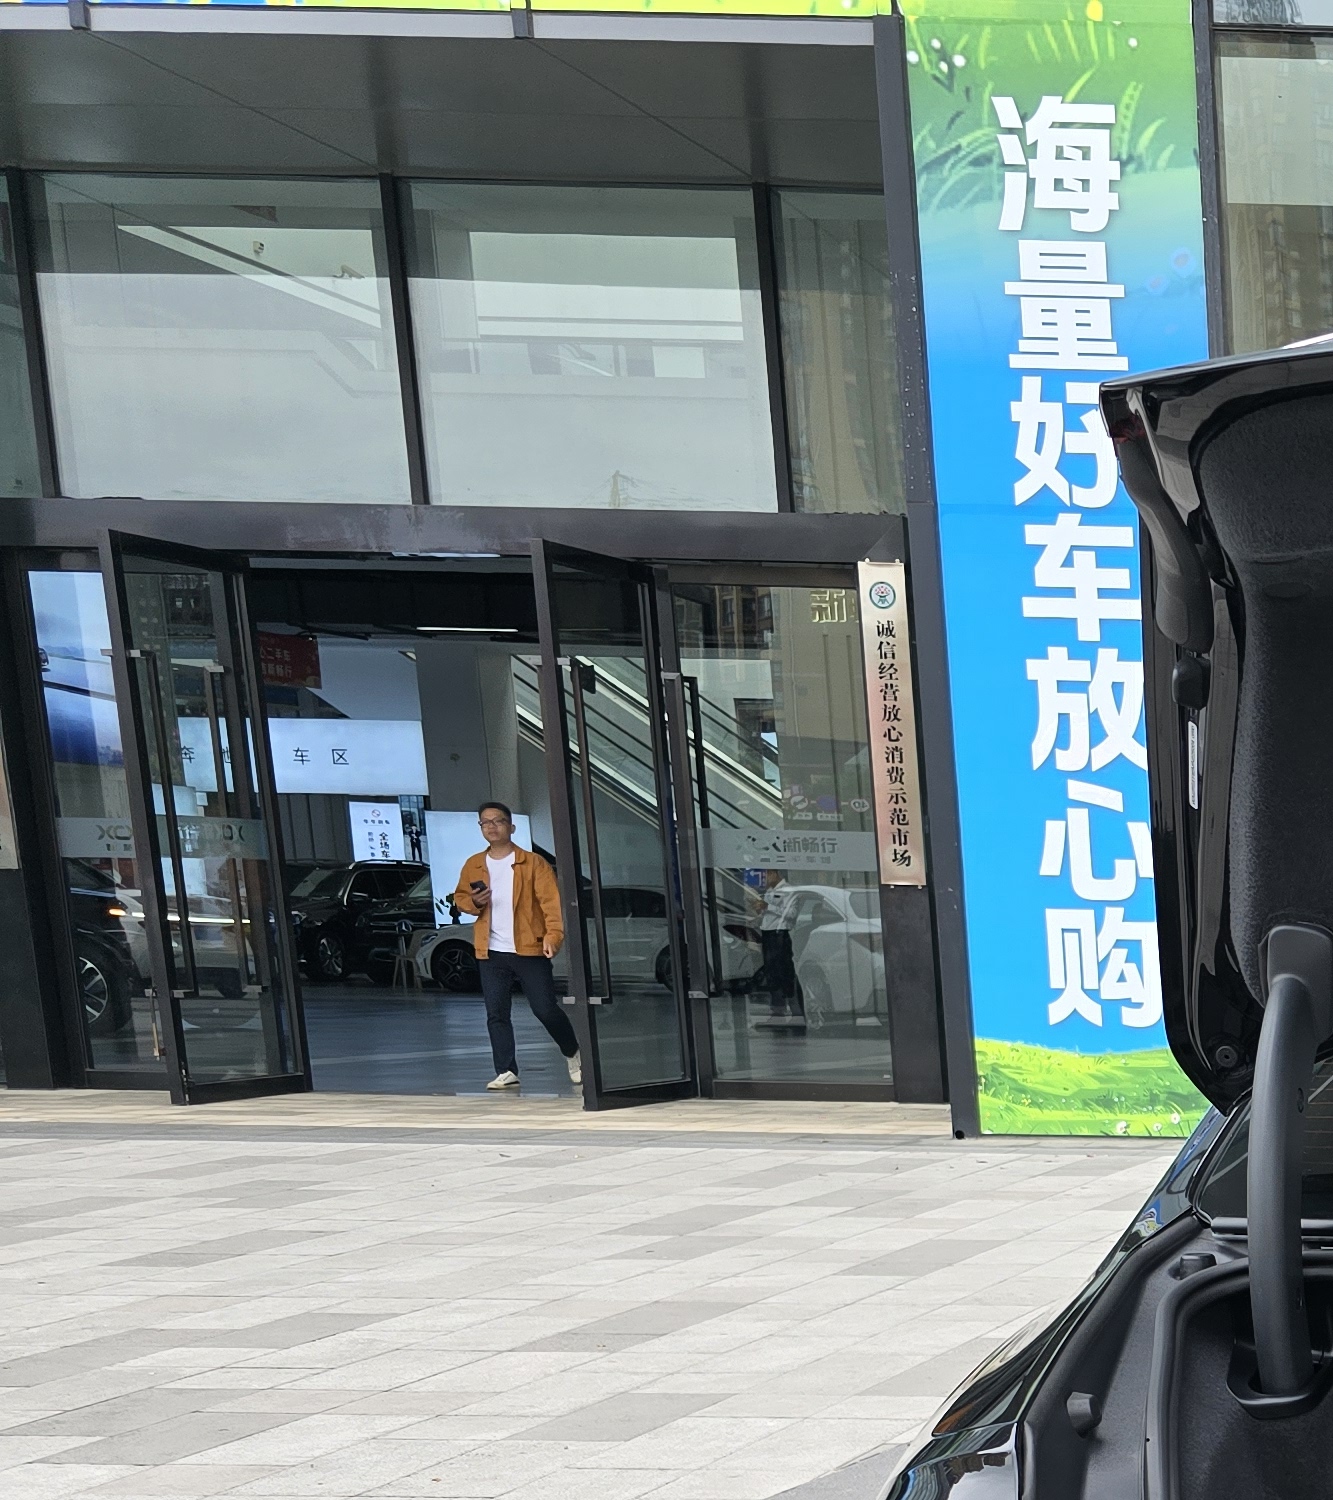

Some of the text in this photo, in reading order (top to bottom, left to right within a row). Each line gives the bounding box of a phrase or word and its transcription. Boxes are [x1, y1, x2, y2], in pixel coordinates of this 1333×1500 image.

[876, 619, 912, 867] 诚信经营放心消费示范市场
[991, 95, 1163, 1028] 海量好车放心购
